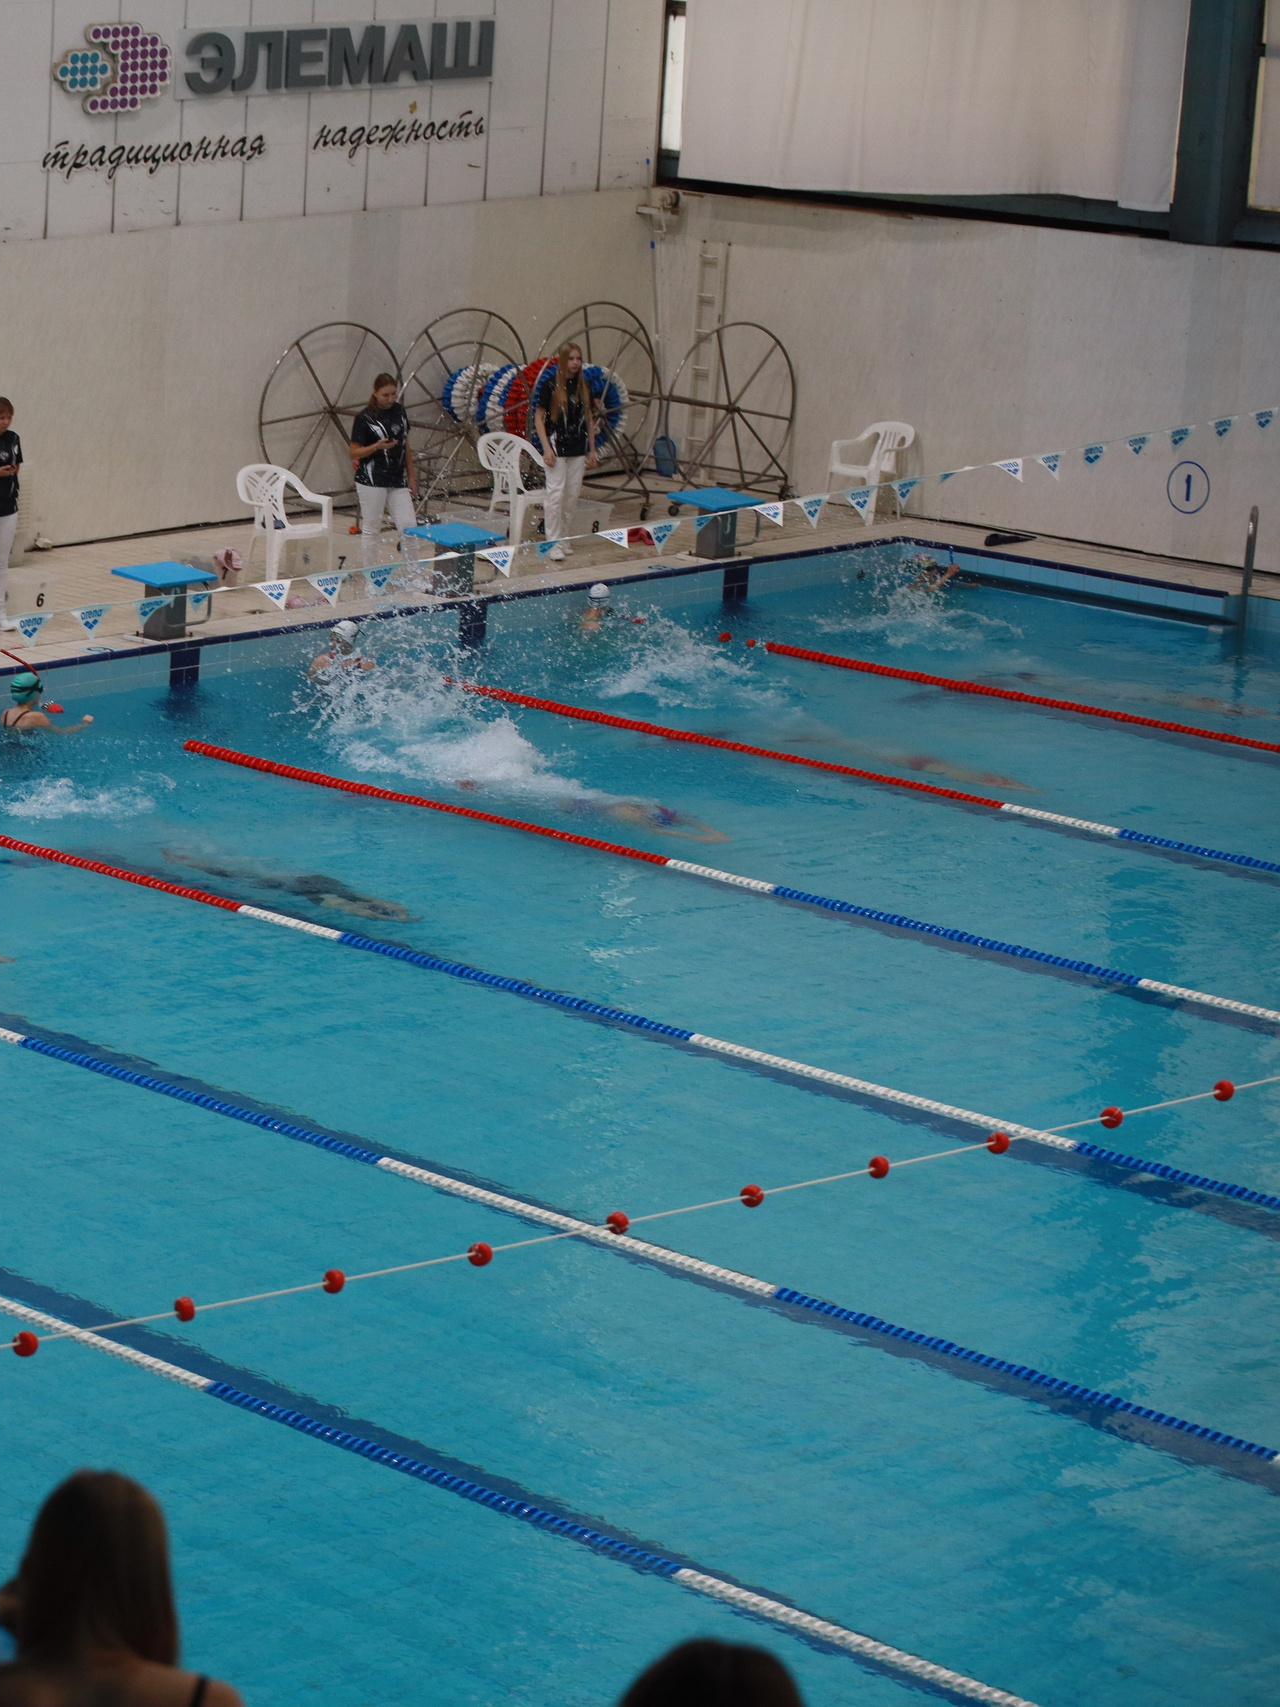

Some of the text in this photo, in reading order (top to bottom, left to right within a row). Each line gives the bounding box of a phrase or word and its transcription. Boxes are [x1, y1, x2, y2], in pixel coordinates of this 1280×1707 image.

[184, 20, 495, 94] ЭЛЕМАШ
[41, 110, 485, 180] традиционная надежность
[592, 520, 599, 533] 8
[338, 555, 346, 569] 7
[36, 592, 44, 607] 6
[20, 617, 43, 629] arena
